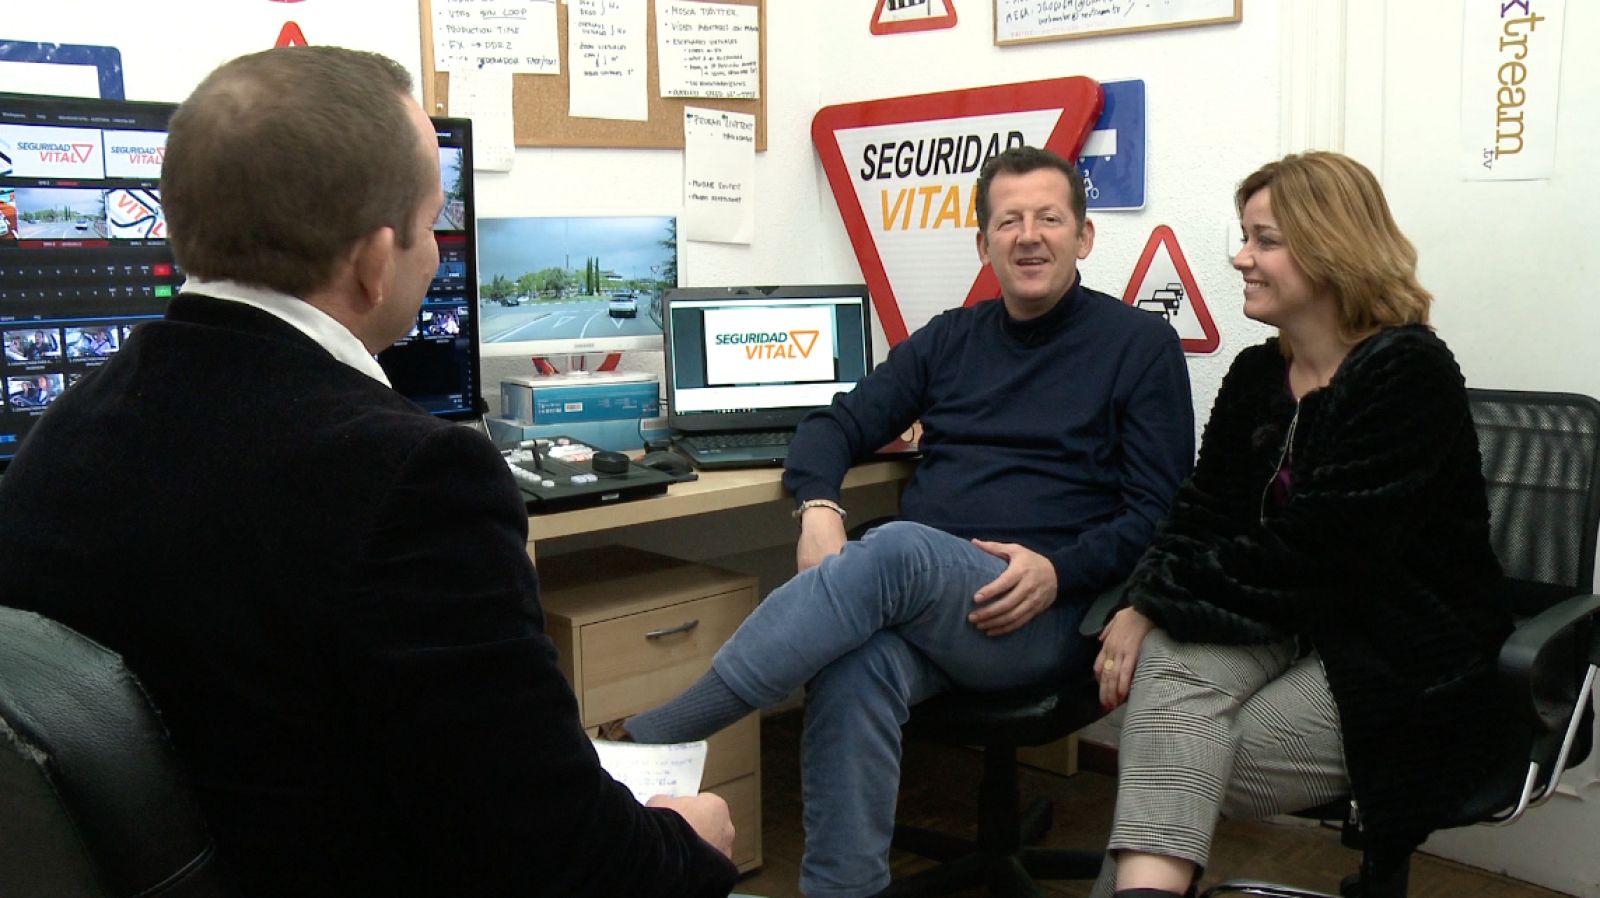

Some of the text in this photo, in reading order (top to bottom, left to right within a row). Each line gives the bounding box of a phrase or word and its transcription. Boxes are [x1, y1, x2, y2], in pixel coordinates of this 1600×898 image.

[446, 24, 492, 34] PRODUCTION
[17, 142, 70, 151] SEGURIDAD
[111, 146, 156, 155] SEGURIDAD
[40, 151, 78, 164] VITAL
[130, 154, 162, 165] VITAL
[715, 332, 788, 345] SEGURIDAD
[745, 344, 797, 360] VITAL
